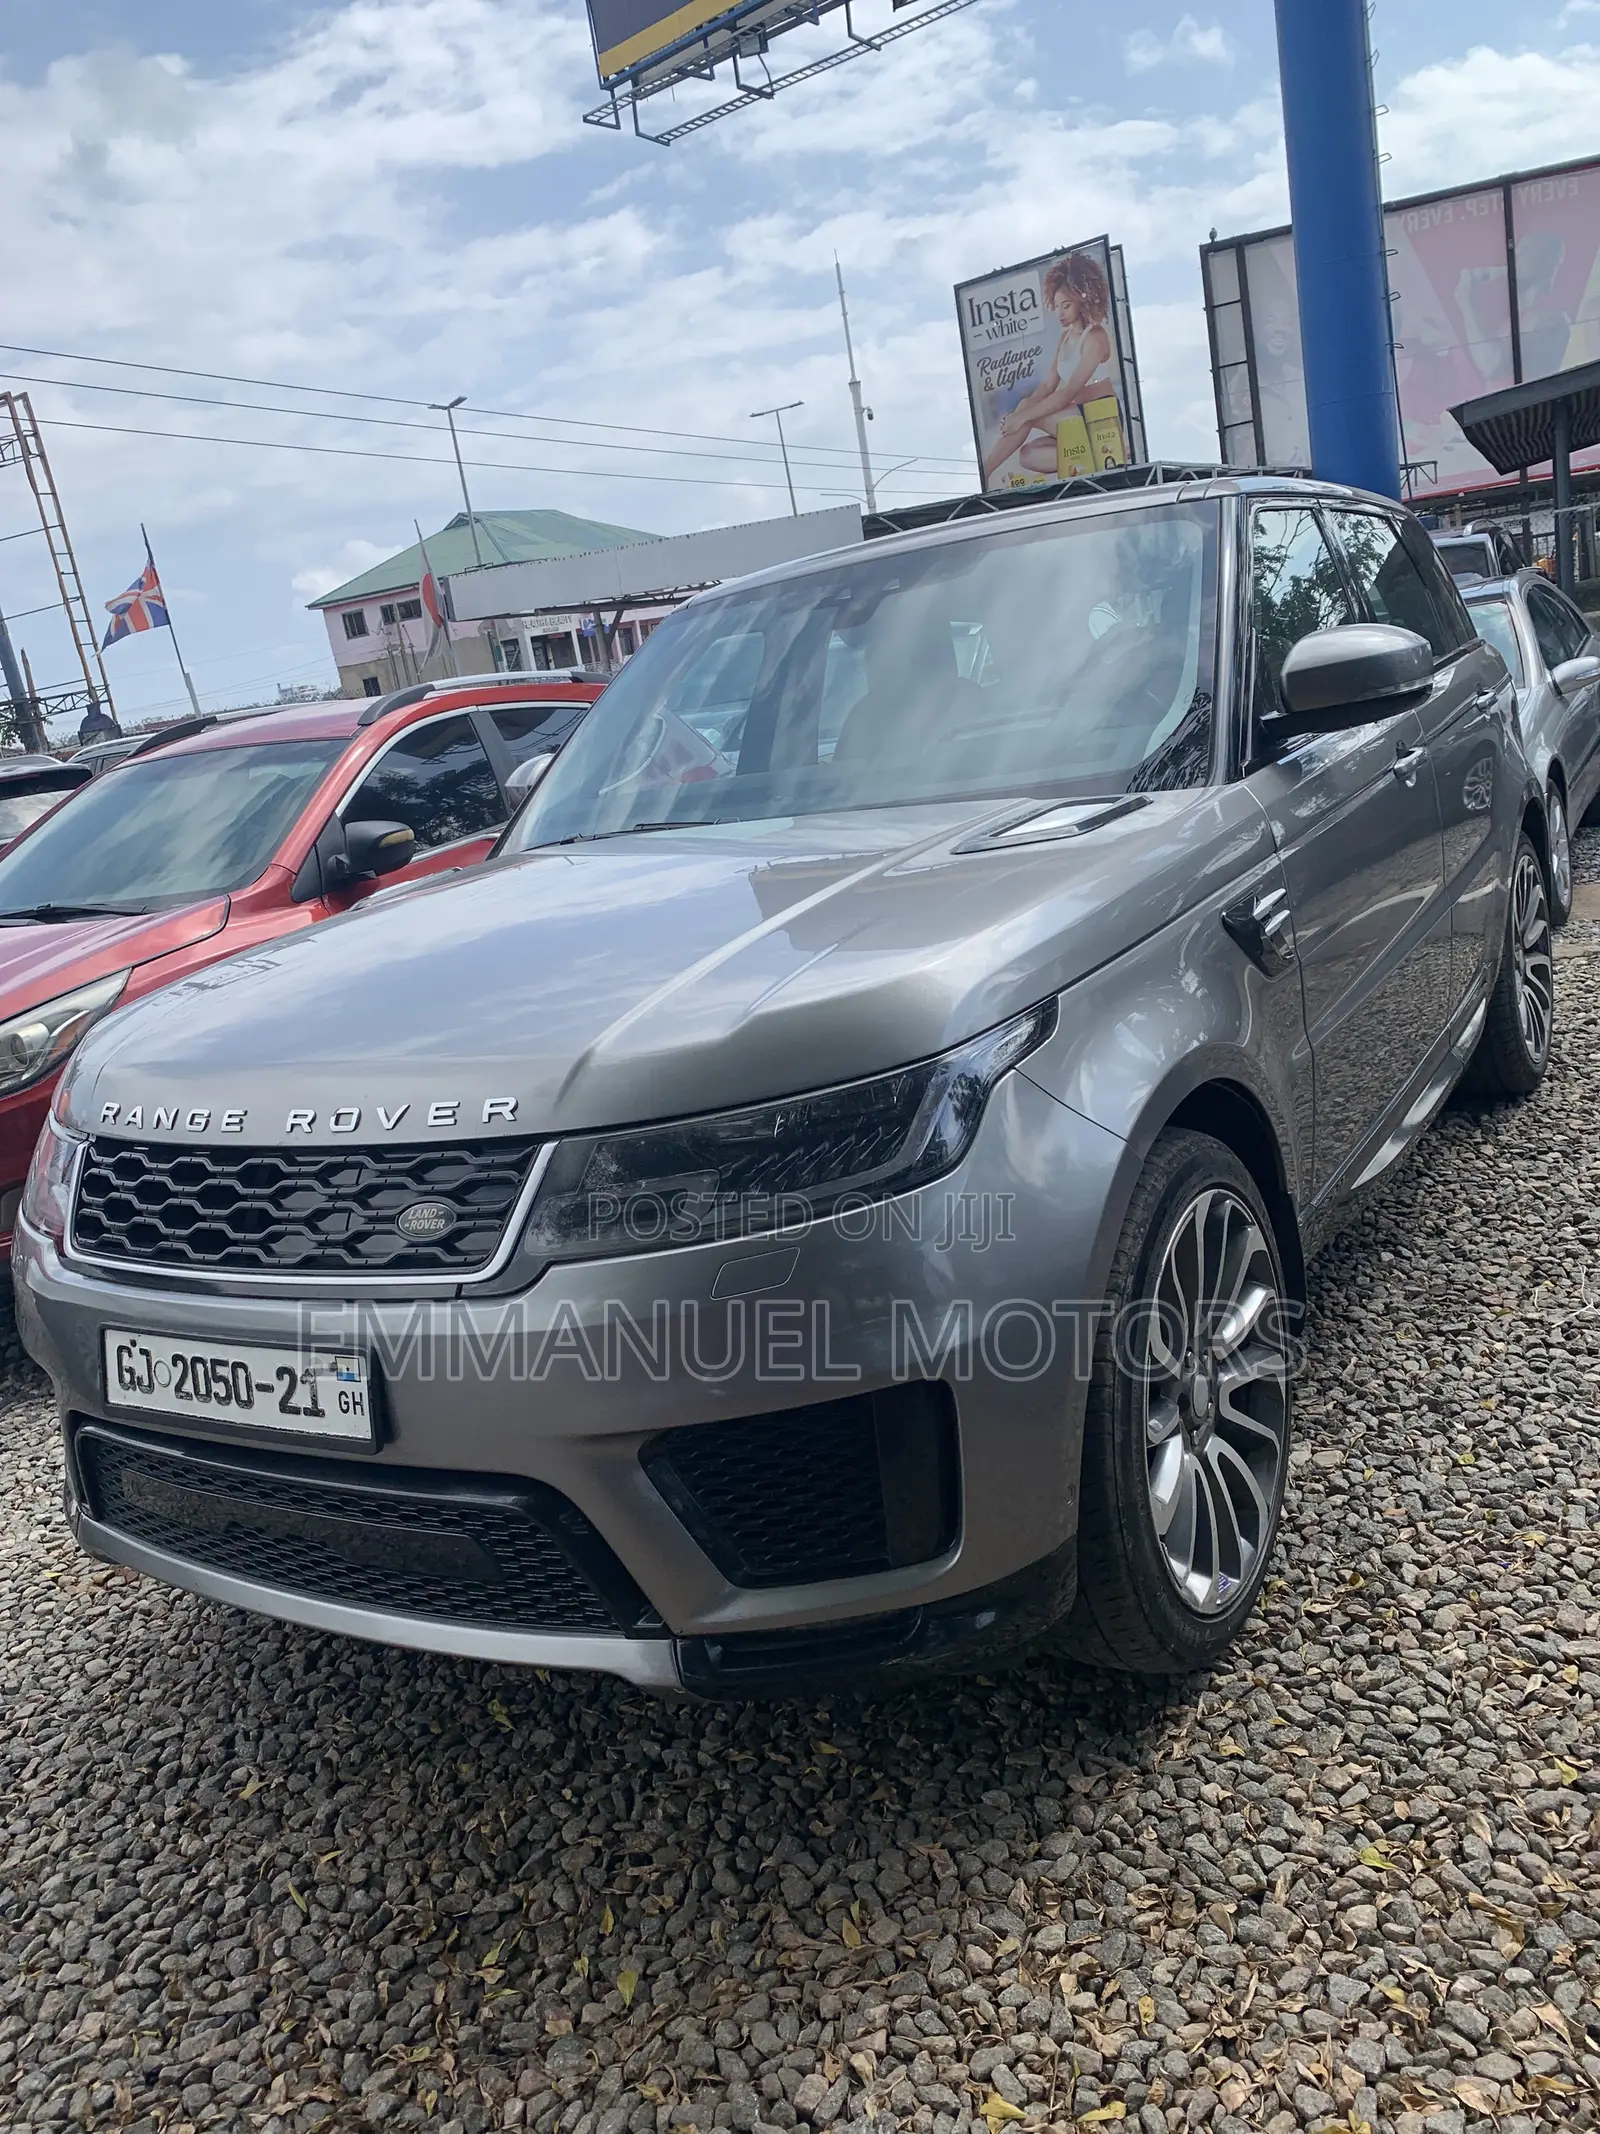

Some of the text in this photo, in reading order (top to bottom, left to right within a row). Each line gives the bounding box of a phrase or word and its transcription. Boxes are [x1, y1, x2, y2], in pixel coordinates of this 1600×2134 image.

[968, 288, 1037, 327] Insta
[986, 318, 1028, 340] white
[976, 345, 1042, 377] Radiance
[983, 359, 1034, 392] & light
[1063, 444, 1086, 458] Insta
[100, 1096, 519, 1134] RANGE ROVER
[408, 1208, 437, 1220] LAND
[409, 1218, 446, 1230] ROVER
[171, 1352, 326, 1418] 2050-21
[338, 1390, 365, 1416] GH
